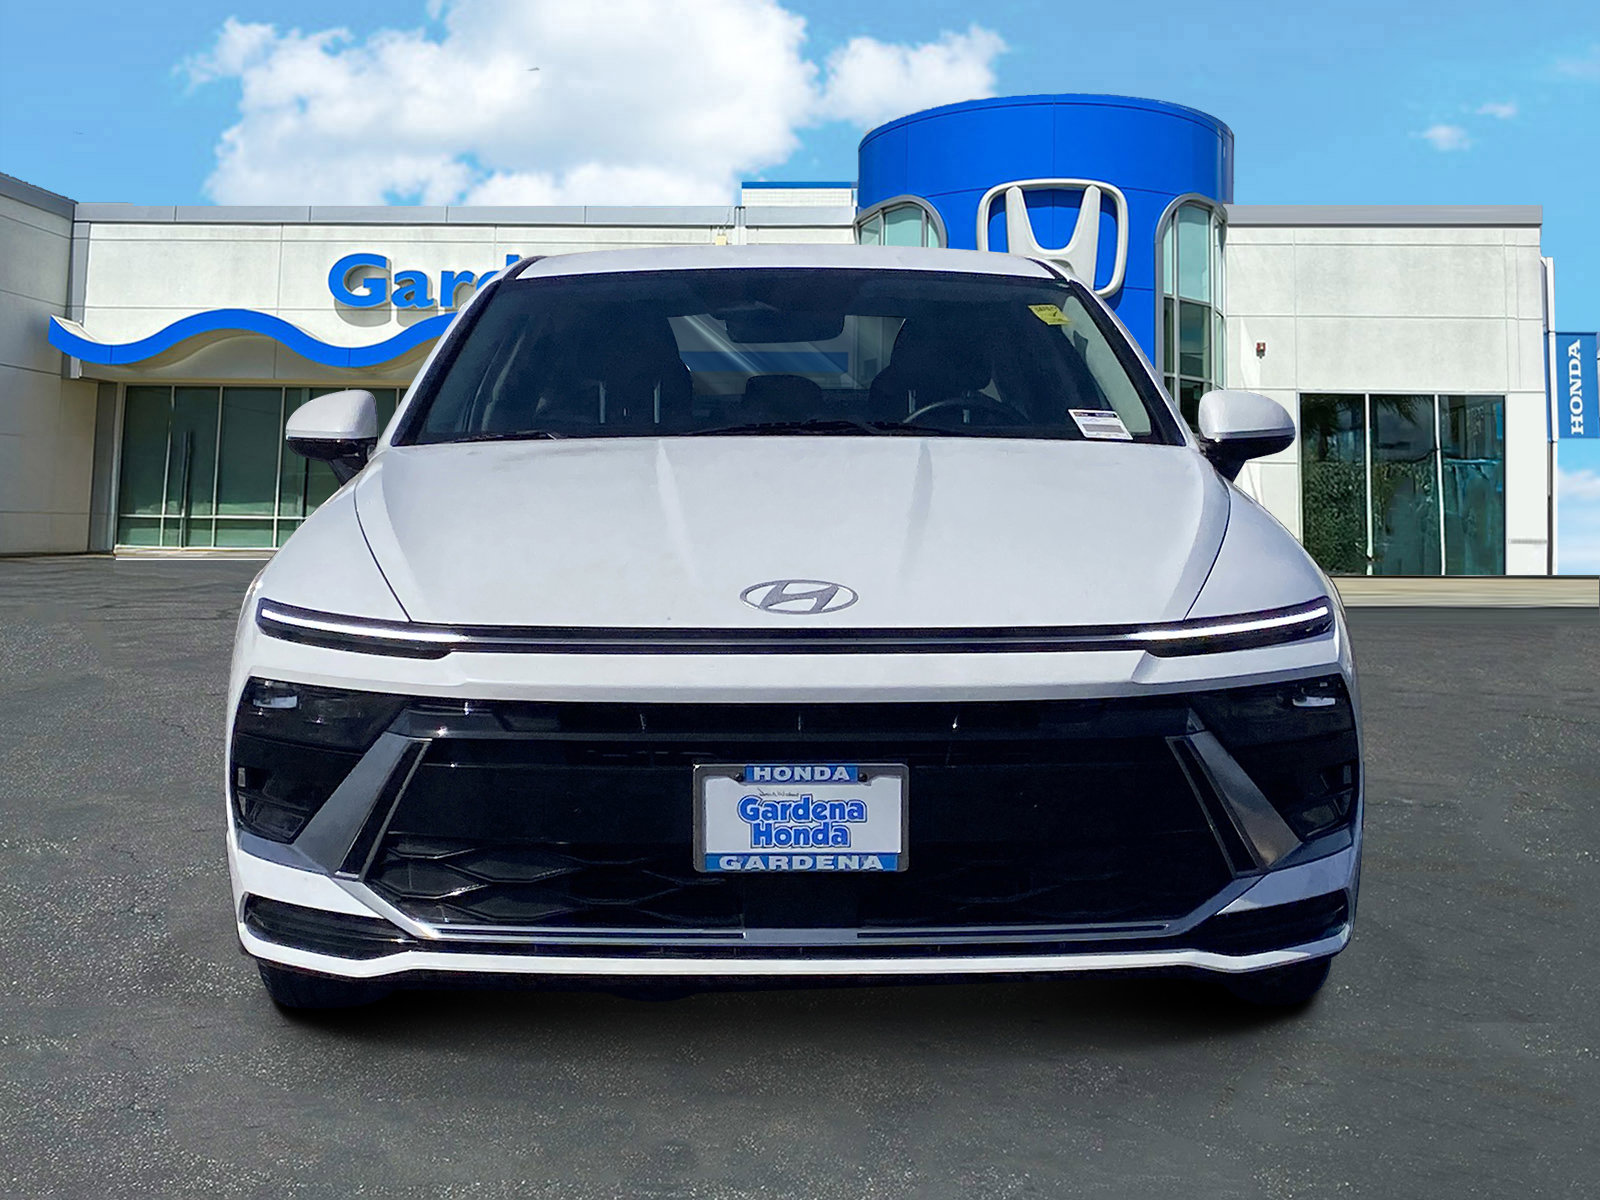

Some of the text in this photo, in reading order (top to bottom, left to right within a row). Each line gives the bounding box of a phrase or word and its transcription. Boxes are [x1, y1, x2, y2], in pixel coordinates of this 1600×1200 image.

[1568, 339, 1584, 435] HONDA
[753, 766, 850, 781] HONDA
[738, 795, 867, 822] Gardena
[751, 822, 851, 848] Honda
[719, 855, 884, 871] GARDENA
